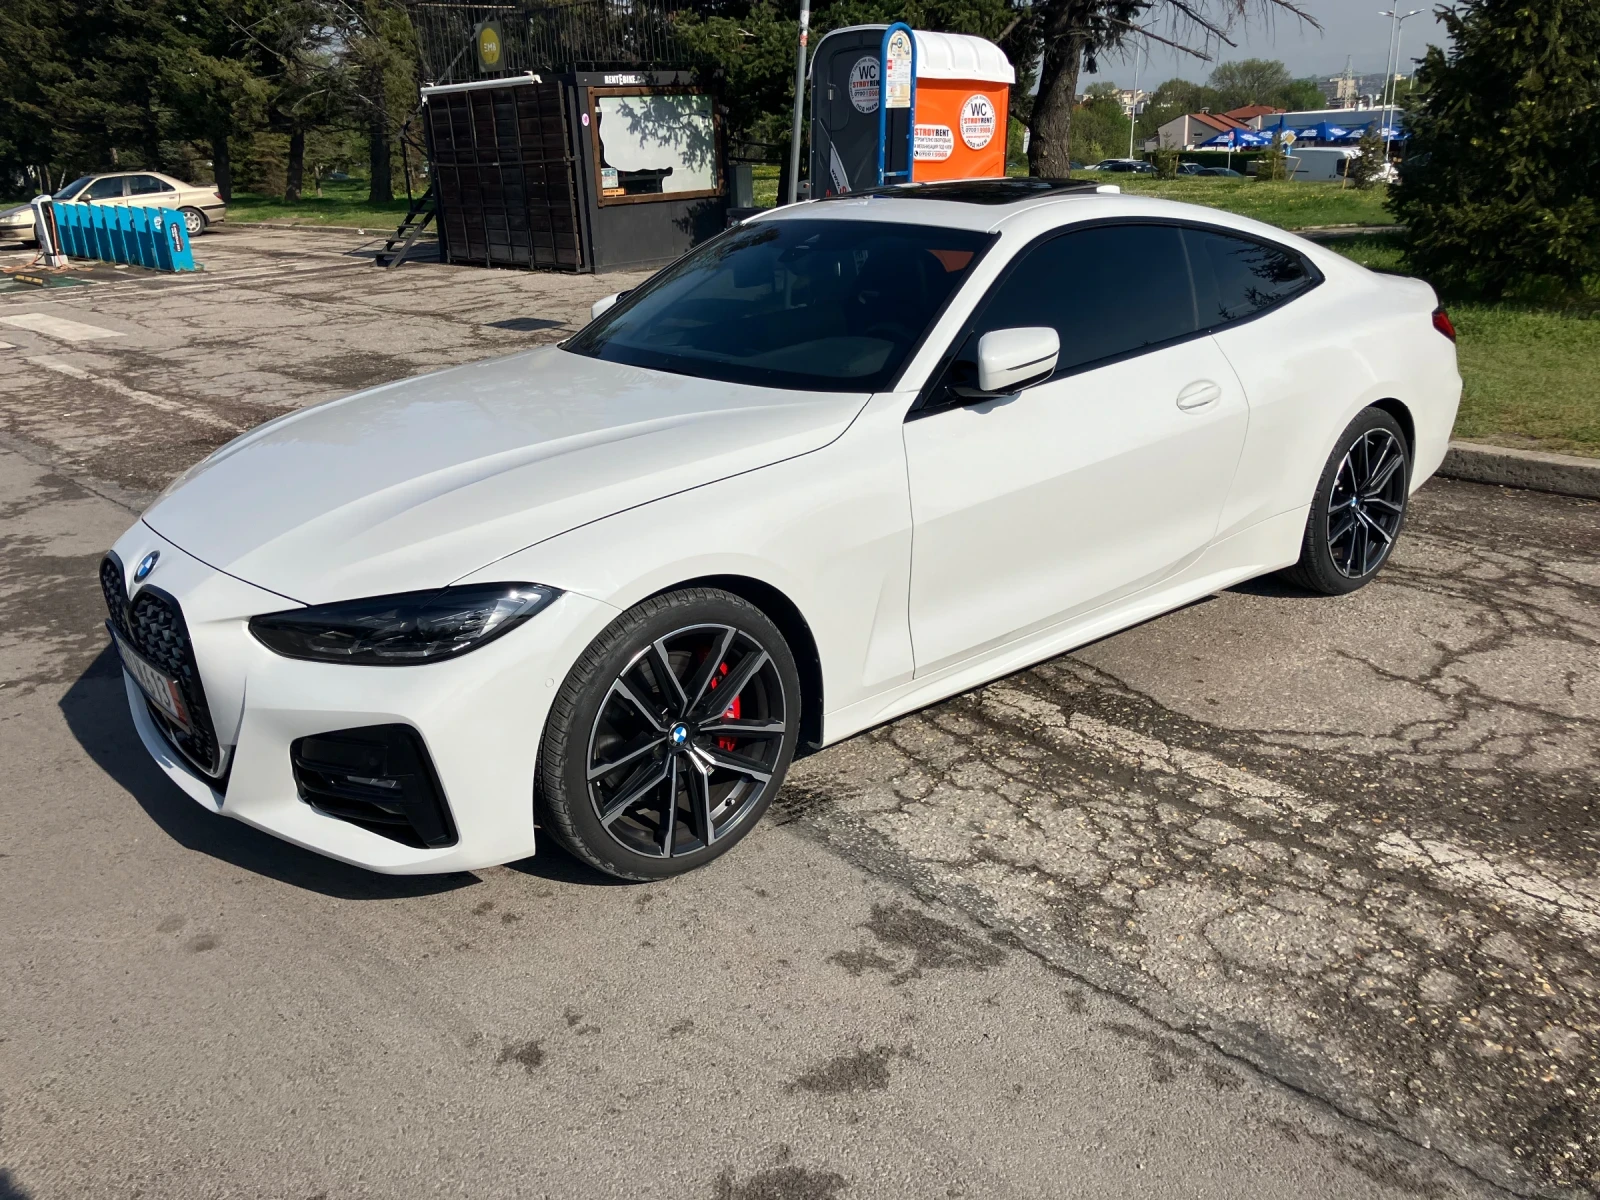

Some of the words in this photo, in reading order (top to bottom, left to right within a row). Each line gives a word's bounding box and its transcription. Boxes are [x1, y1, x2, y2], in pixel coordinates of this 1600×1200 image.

[859, 65, 876, 79] WC
[853, 80, 879, 88] STROYREN
[971, 103, 987, 116] WC
[915, 128, 949, 137] STROYRENT
